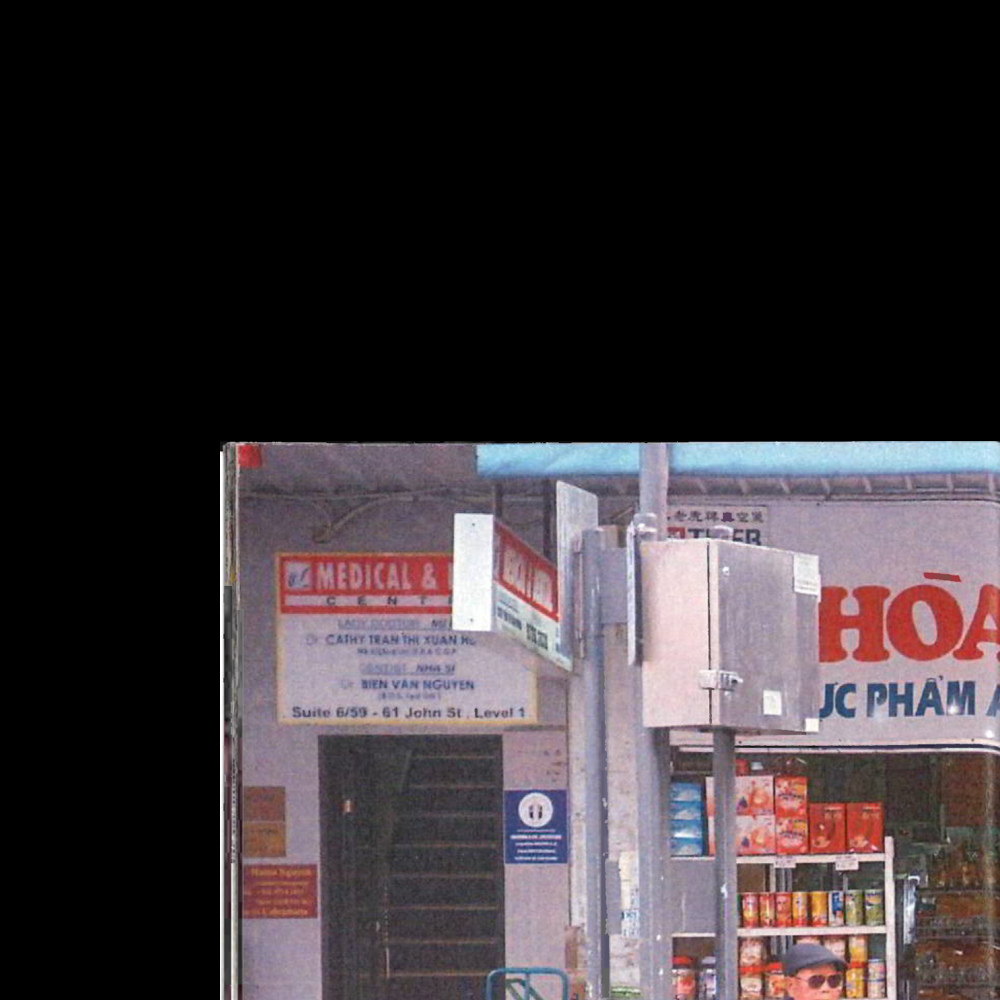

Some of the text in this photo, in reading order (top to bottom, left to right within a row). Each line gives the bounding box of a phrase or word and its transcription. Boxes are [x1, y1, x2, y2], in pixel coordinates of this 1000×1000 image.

[316, 561, 436, 590] MEDICAL &
[325, 634, 365, 646] CATHY
[368, 634, 397, 646] TRAN
[423, 634, 456, 646] XUAN
[361, 679, 389, 691] BIEN
[422, 679, 476, 691] NGUYEN
[292, 706, 330, 718] Suite
[336, 706, 368, 718] 6/59
[382, 706, 399, 718] 61
[404, 706, 441, 718] John
[474, 706, 513, 718] Level
